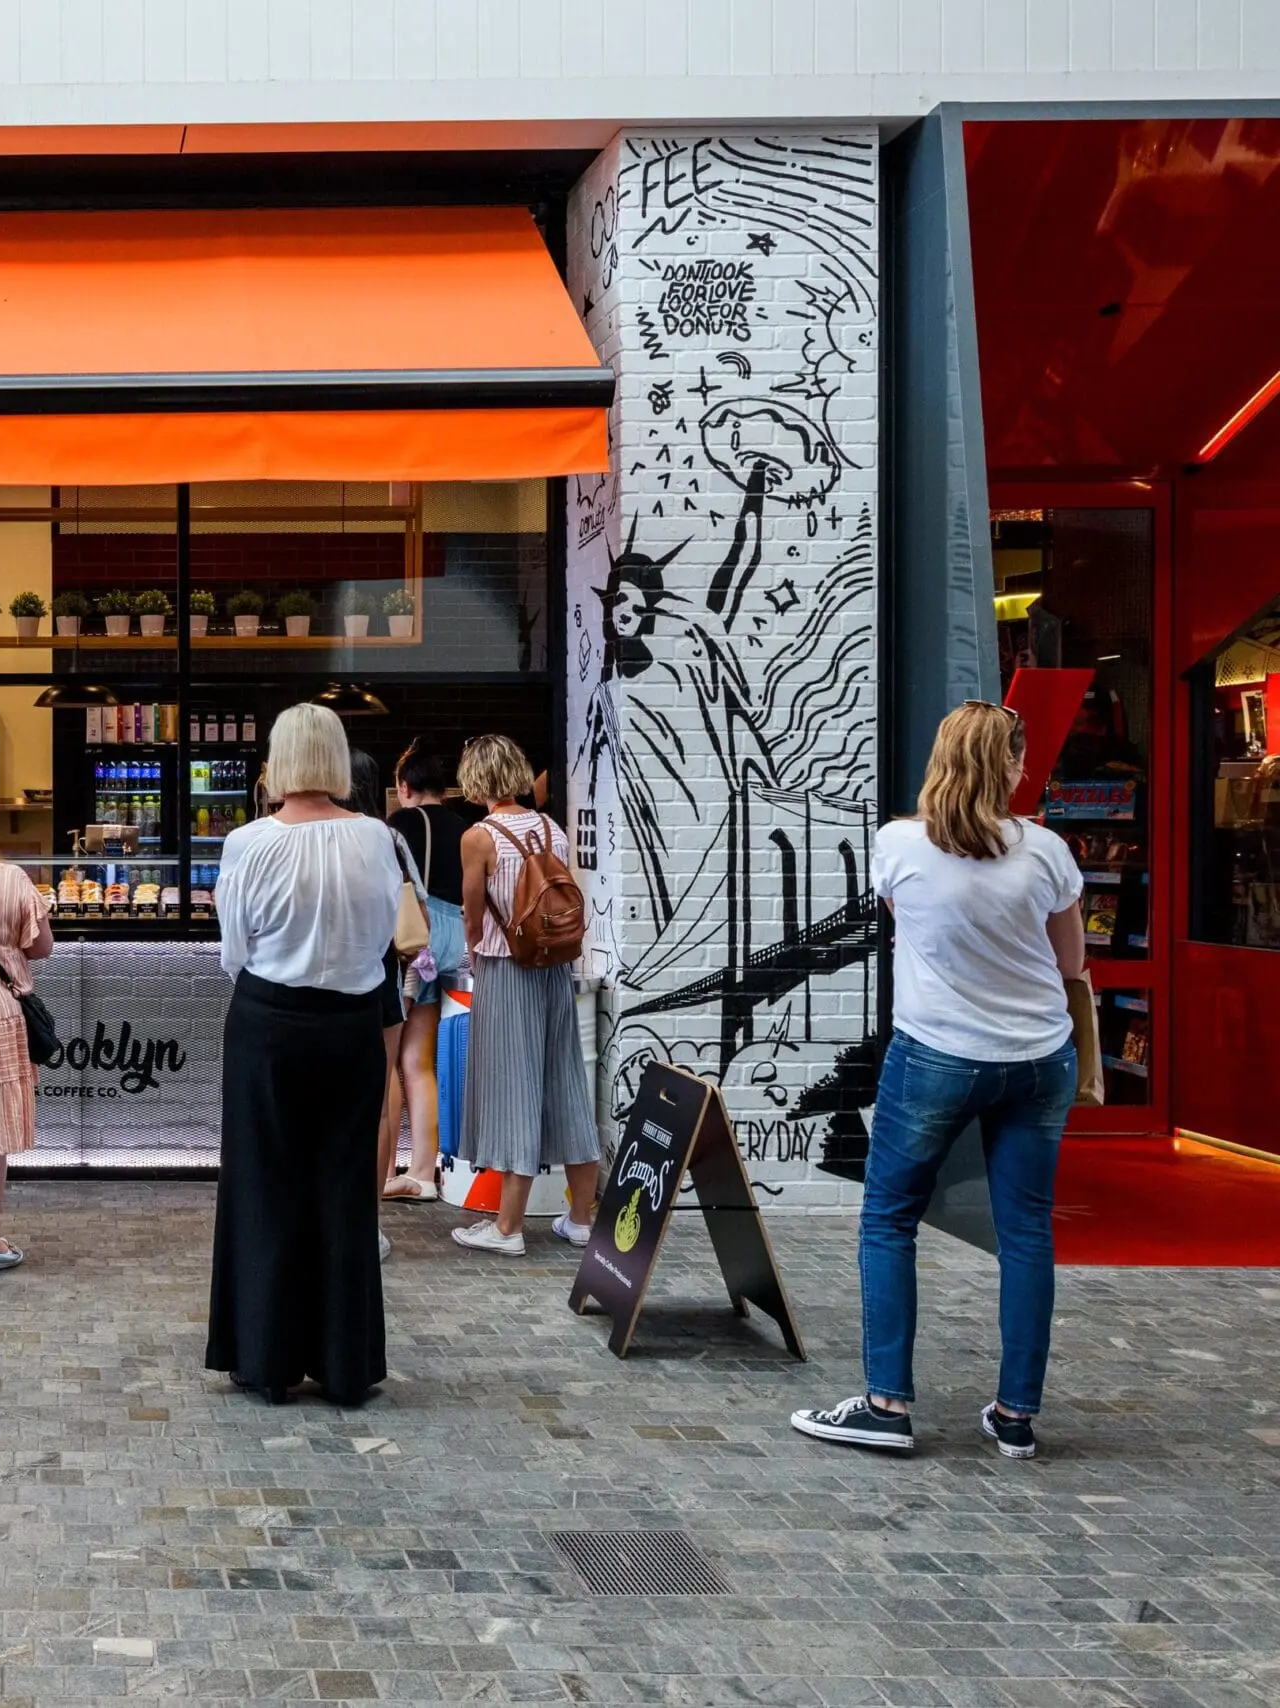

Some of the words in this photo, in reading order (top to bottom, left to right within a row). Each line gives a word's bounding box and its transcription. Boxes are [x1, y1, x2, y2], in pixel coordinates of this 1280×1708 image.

[703, 261, 754, 284] LOOK
[667, 281, 708, 302] FOR
[708, 281, 757, 304] LOVE
[658, 292, 707, 318] LOOK
[707, 302, 747, 321] FOR
[663, 314, 752, 342] DONUTS
[1050, 788, 1132, 803] PUZZLES
[44, 1086, 94, 1098] COFFEE
